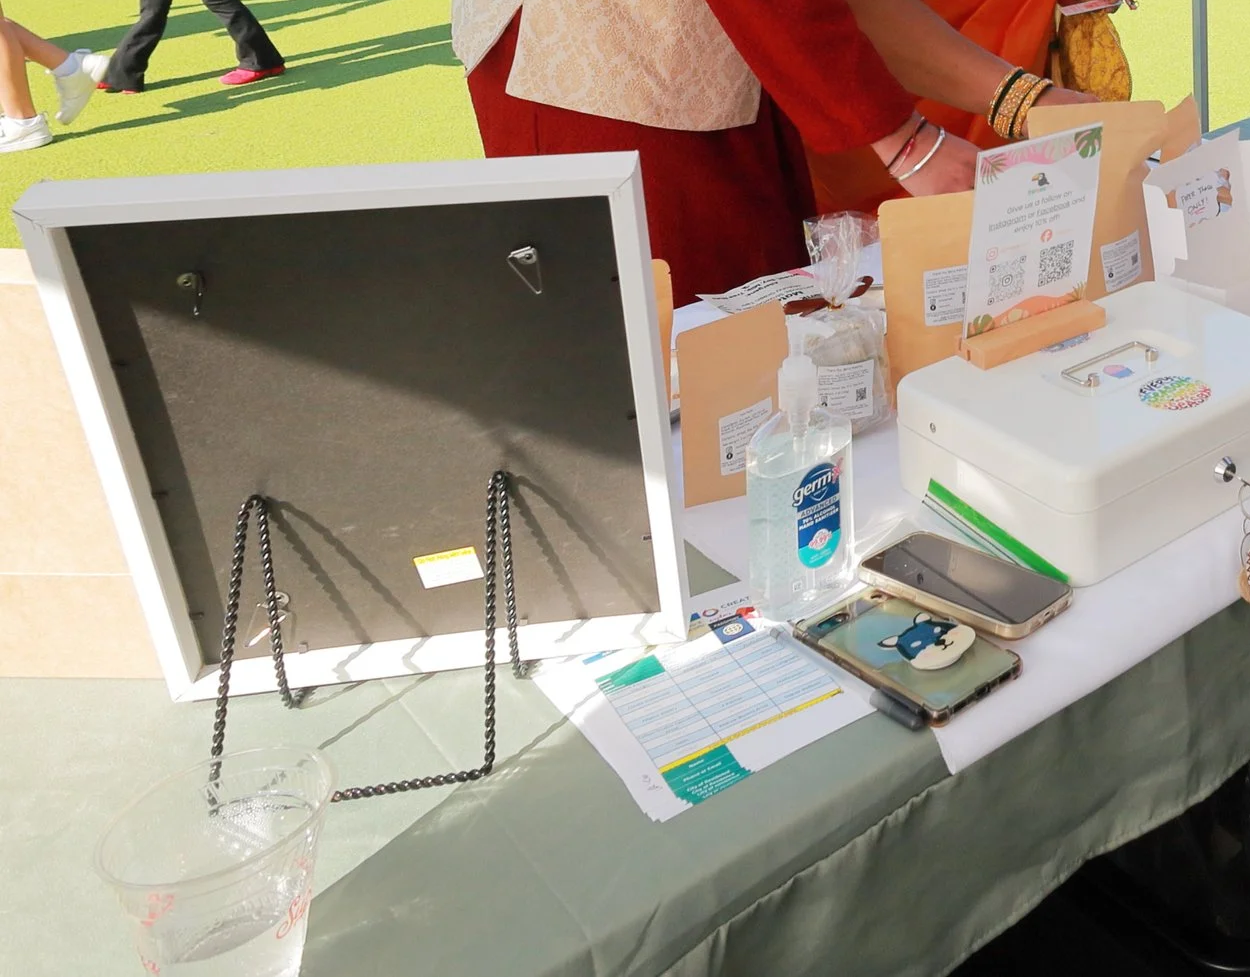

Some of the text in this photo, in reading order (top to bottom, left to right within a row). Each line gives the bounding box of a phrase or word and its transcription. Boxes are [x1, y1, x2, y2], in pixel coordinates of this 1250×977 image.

[988, 195, 1086, 232] Instagram or Facebook and
[1006, 204, 1024, 214] Give
[1041, 193, 1062, 205] follow
[1013, 221, 1033, 233] enjoy
[801, 496, 837, 518] ADVANCED
[813, 506, 836, 519] ALCOHOL
[798, 508, 839, 531] HAND SANITIZER
[683, 771, 700, 782] Phone
[707, 761, 722, 771] Email
[688, 759, 705, 769] Name
[686, 785, 698, 793] City
